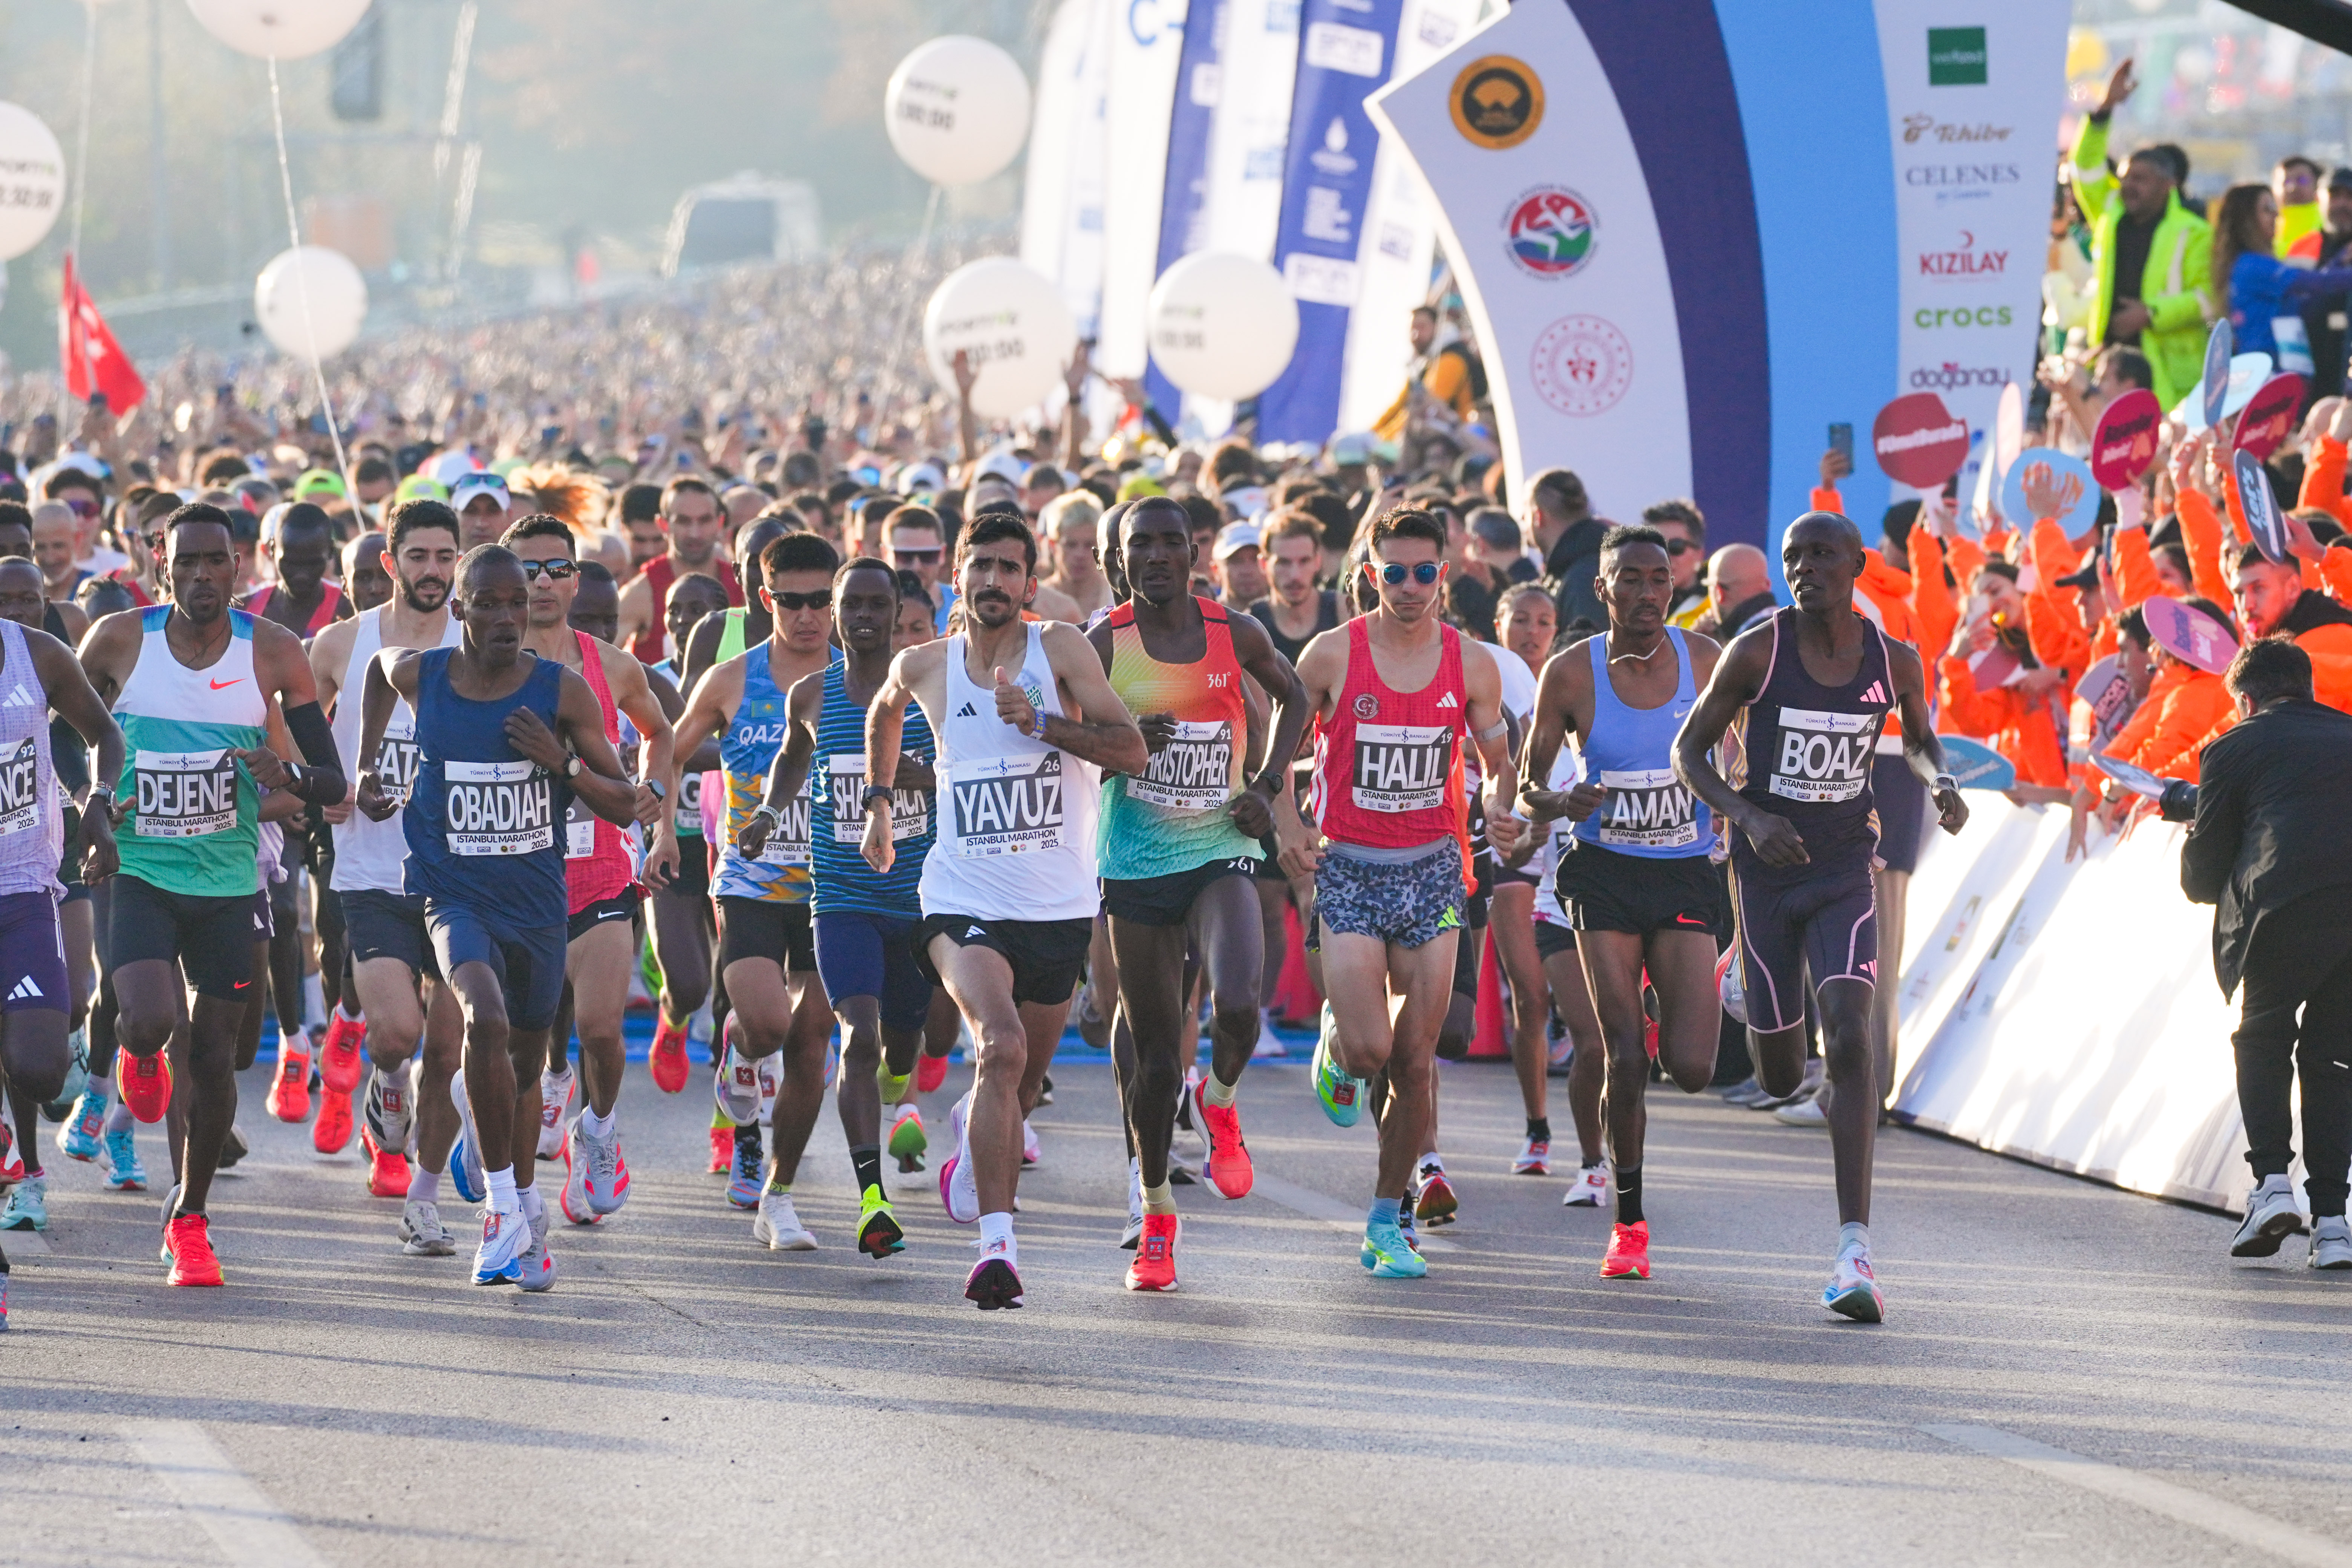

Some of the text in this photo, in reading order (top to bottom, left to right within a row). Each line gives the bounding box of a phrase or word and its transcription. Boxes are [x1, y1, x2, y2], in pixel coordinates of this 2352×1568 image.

[1906, 164, 2021, 186] CELENES
[1920, 251, 2008, 275] KIZILAY
[1914, 306, 2012, 329] crocs
[1866, 720, 1876, 732] 94
[739, 724, 785, 746] QAZ
[1220, 728, 1231, 740] 91
[1441, 732, 1453, 744] 19
[20, 744, 35, 758] 92
[1779, 730, 1871, 779] BOAZ
[226, 756, 234, 767] 1
[1044, 759, 1060, 772] 26
[1136, 743, 1230, 786] HRISTOPHER
[1361, 745, 1444, 789] HALİL
[0, 759, 34, 812] NCE
[1137, 781, 1220, 798] ISTANBUL MARATHON
[1780, 778, 1859, 792] ISTANBUL MARATHON
[138, 771, 234, 816] DEJENE
[1361, 789, 1437, 801] ISTANBUL MARATHON
[1844, 790, 1859, 799] 2025
[448, 779, 550, 831] OBADIAH
[955, 775, 1063, 833] YAVUZ
[1423, 798, 1439, 807] 2025
[1610, 786, 1692, 829] AMAN
[0, 807, 31, 824] ARATHON
[145, 813, 229, 827] ISTANBUL MARATHON
[17, 817, 35, 829] 2025
[214, 821, 231, 831] 2025
[892, 818, 920, 829] RATHON
[457, 829, 546, 844] ISTANBUL MARATHON
[907, 826, 922, 836] 2025
[966, 828, 1056, 846] ISTANBUL MARATHON
[1649, 824, 1690, 838] MARATHON
[531, 838, 548, 850] 2025
[1041, 838, 1059, 849] 2025
[1677, 833, 1694, 845] 2025
[766, 843, 802, 851] ISTANBUL
